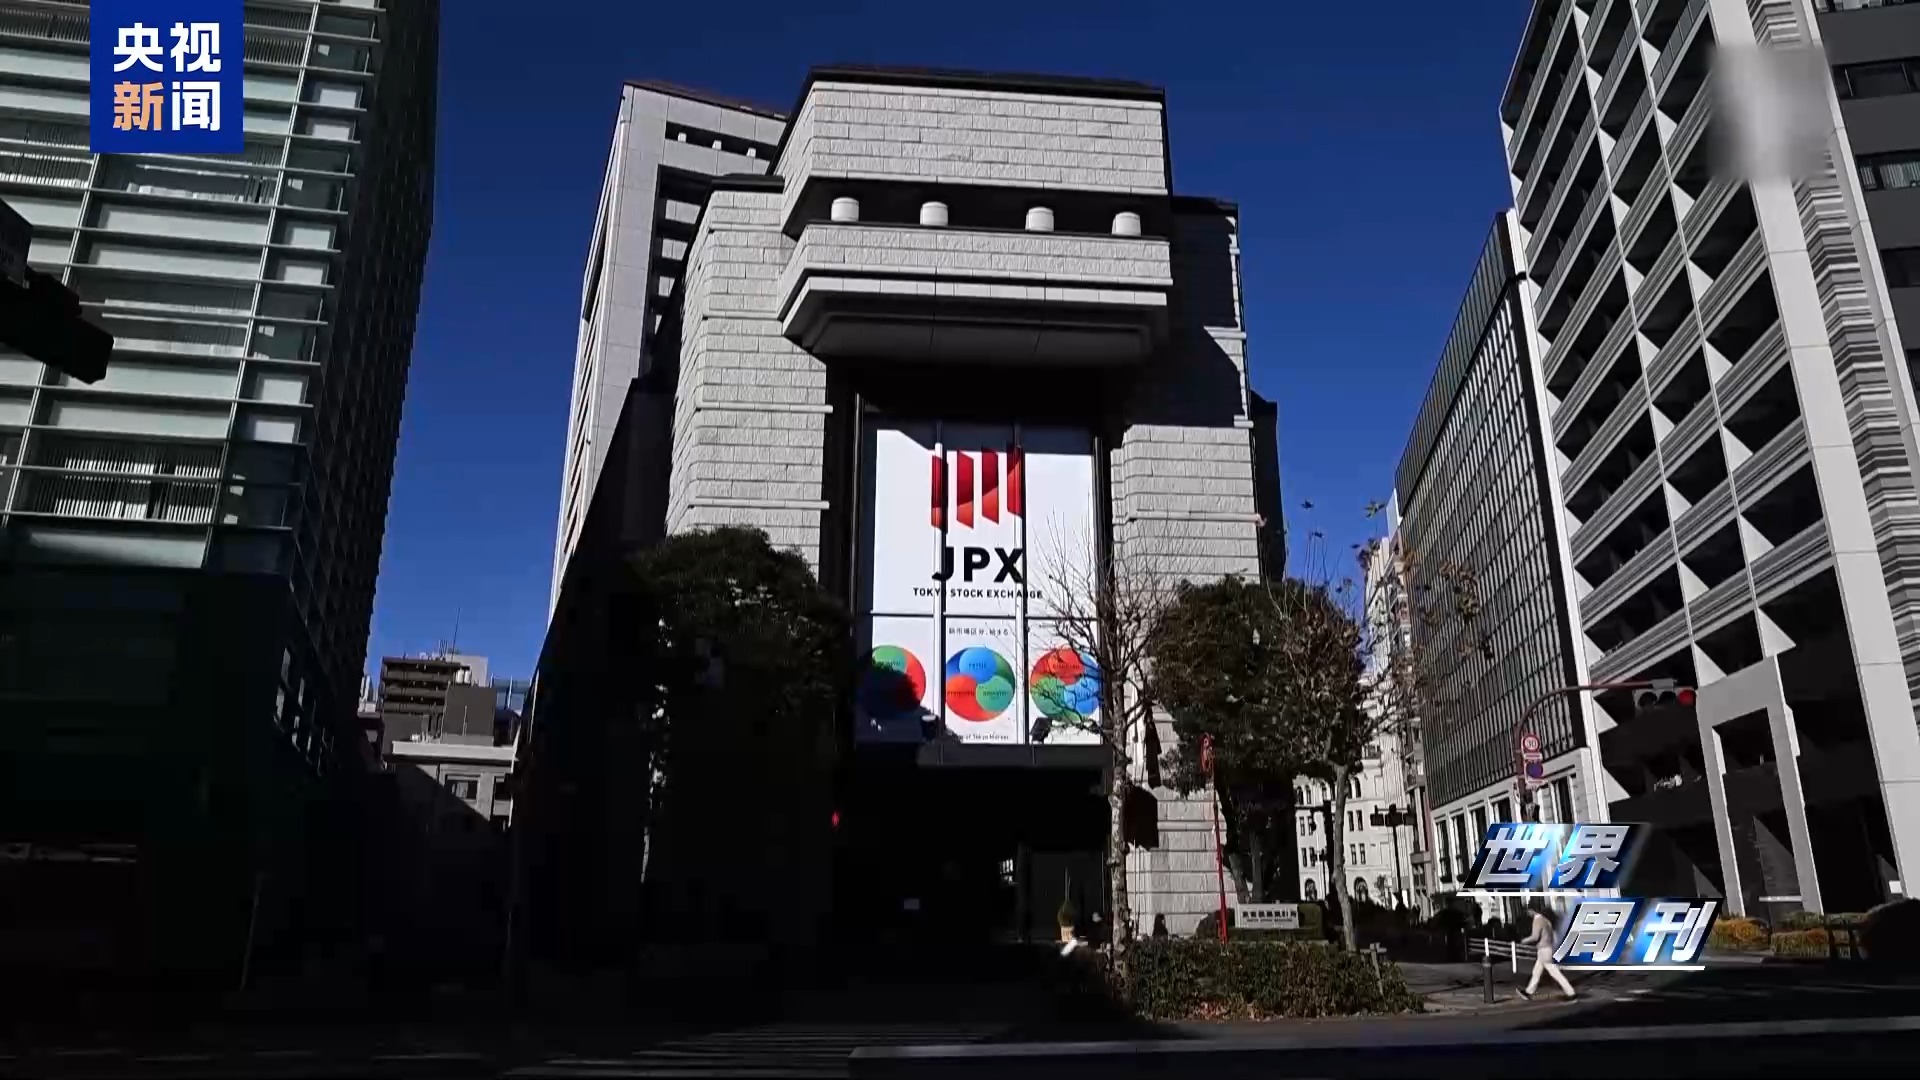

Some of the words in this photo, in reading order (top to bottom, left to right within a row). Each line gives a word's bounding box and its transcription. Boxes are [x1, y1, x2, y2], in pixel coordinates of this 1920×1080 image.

[932, 546, 1024, 584] JPX
[913, 587, 947, 597] TOKY
[950, 588, 983, 598] STOCK
[987, 589, 1043, 599] EXCHAGE
